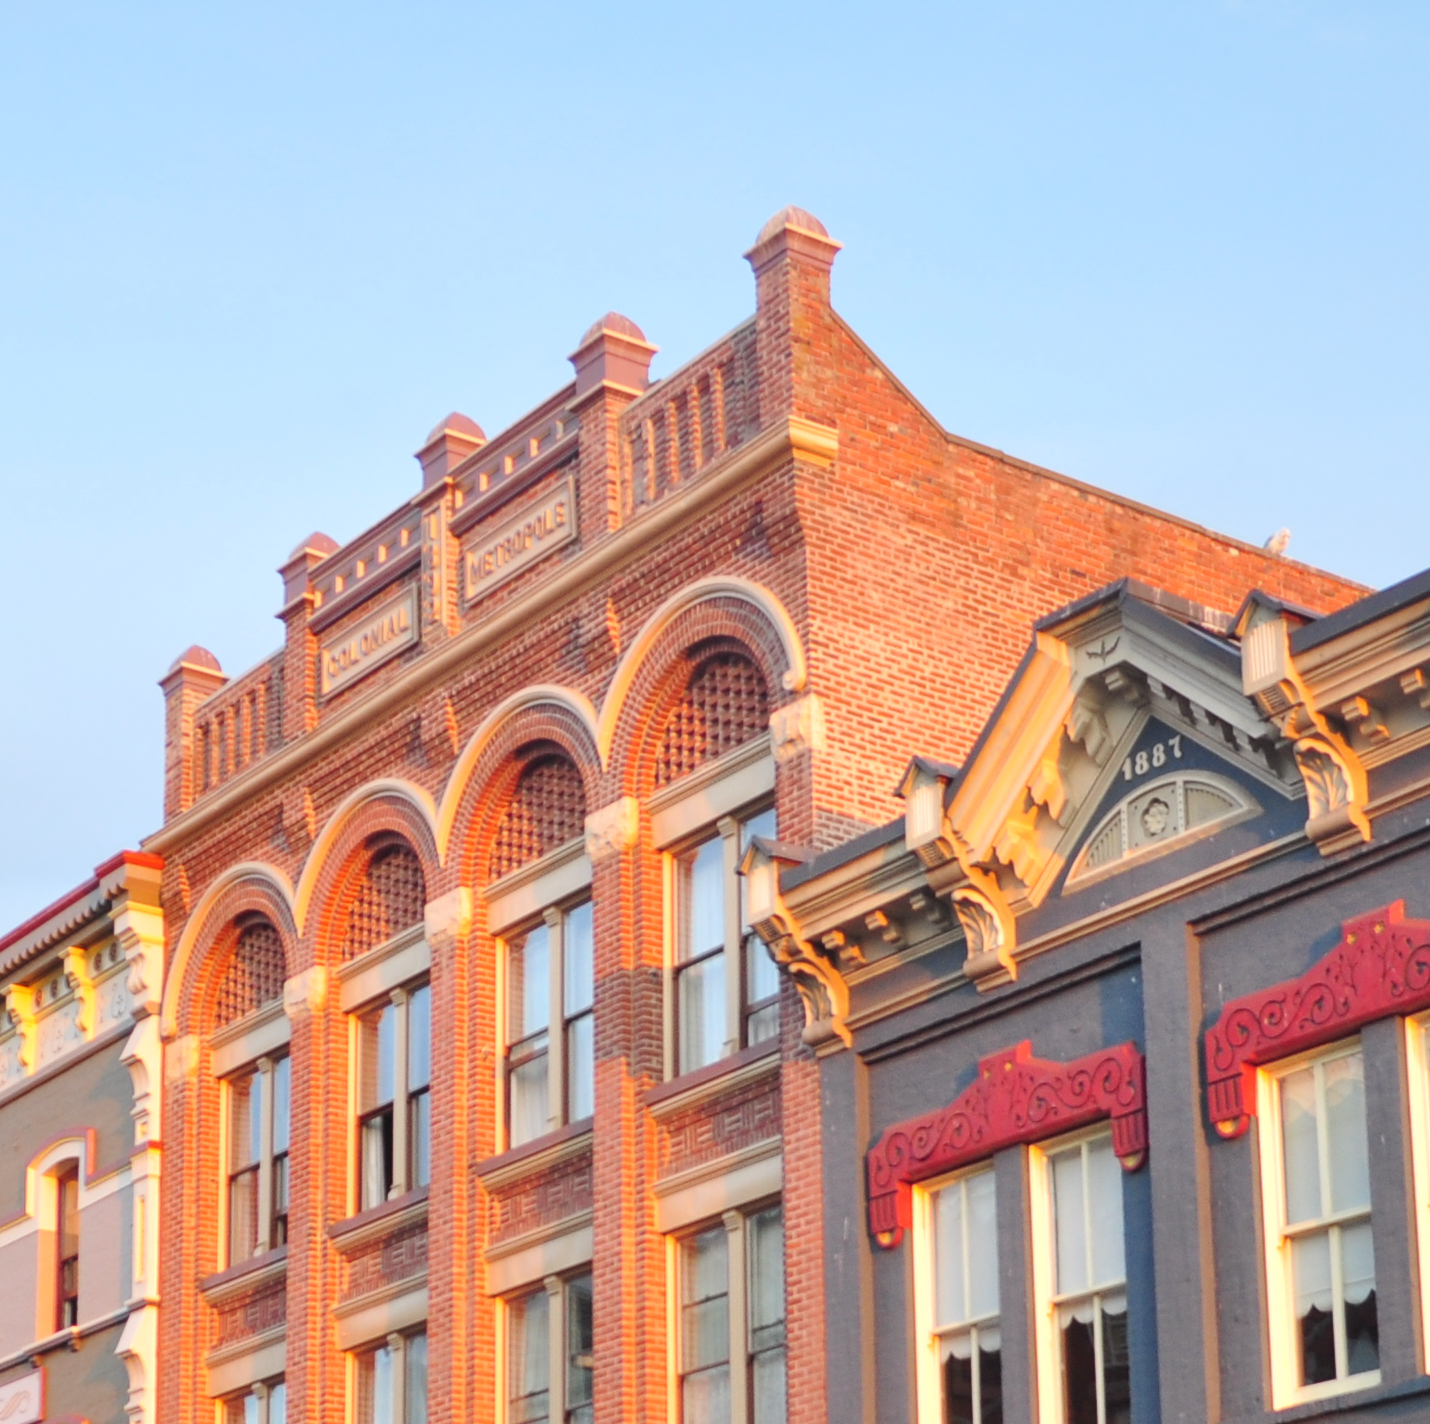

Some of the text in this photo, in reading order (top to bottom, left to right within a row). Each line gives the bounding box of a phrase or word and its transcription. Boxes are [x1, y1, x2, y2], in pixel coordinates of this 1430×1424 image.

[469, 502, 566, 583] METROPOLE
[327, 608, 409, 677] COLONIAL
[1121, 735, 1183, 781] 1887
